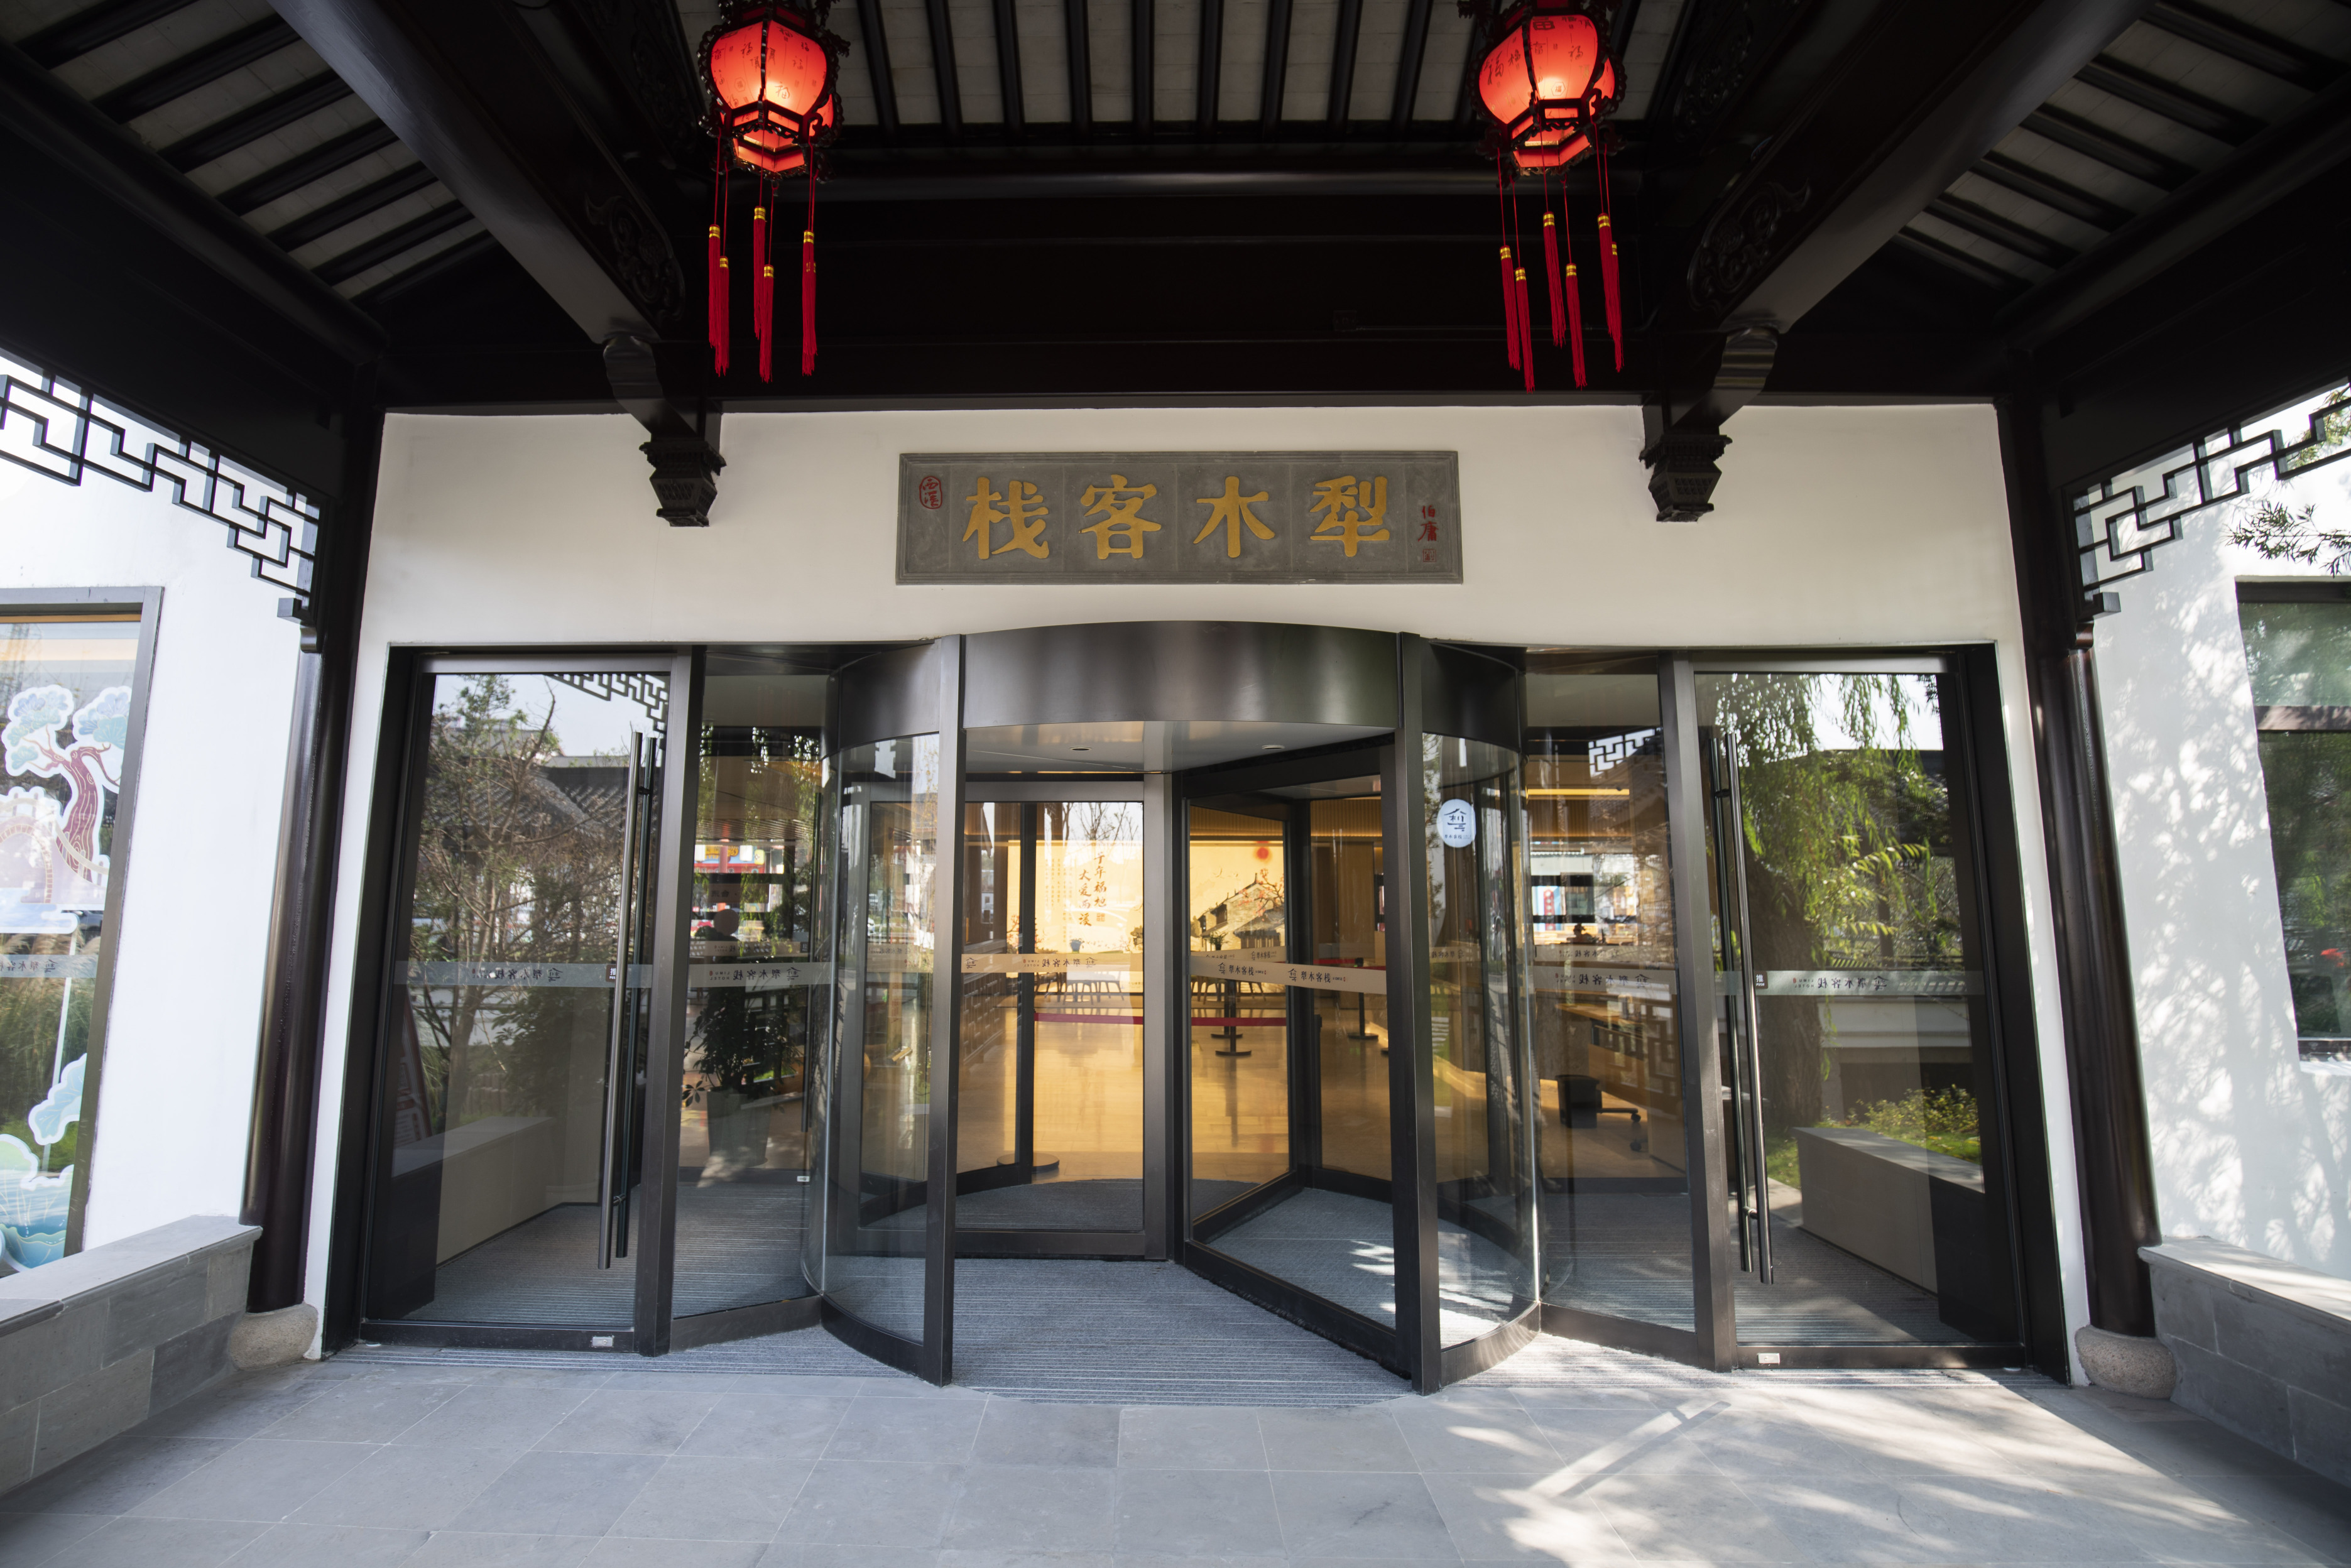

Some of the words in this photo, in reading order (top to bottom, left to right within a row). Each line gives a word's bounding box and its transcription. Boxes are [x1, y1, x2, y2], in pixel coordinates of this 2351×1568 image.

[1228, 964, 1254, 976] 犁木客栈
[1301, 971, 1331, 983] 犁木客栈
[1756, 974, 1764, 983] 推
